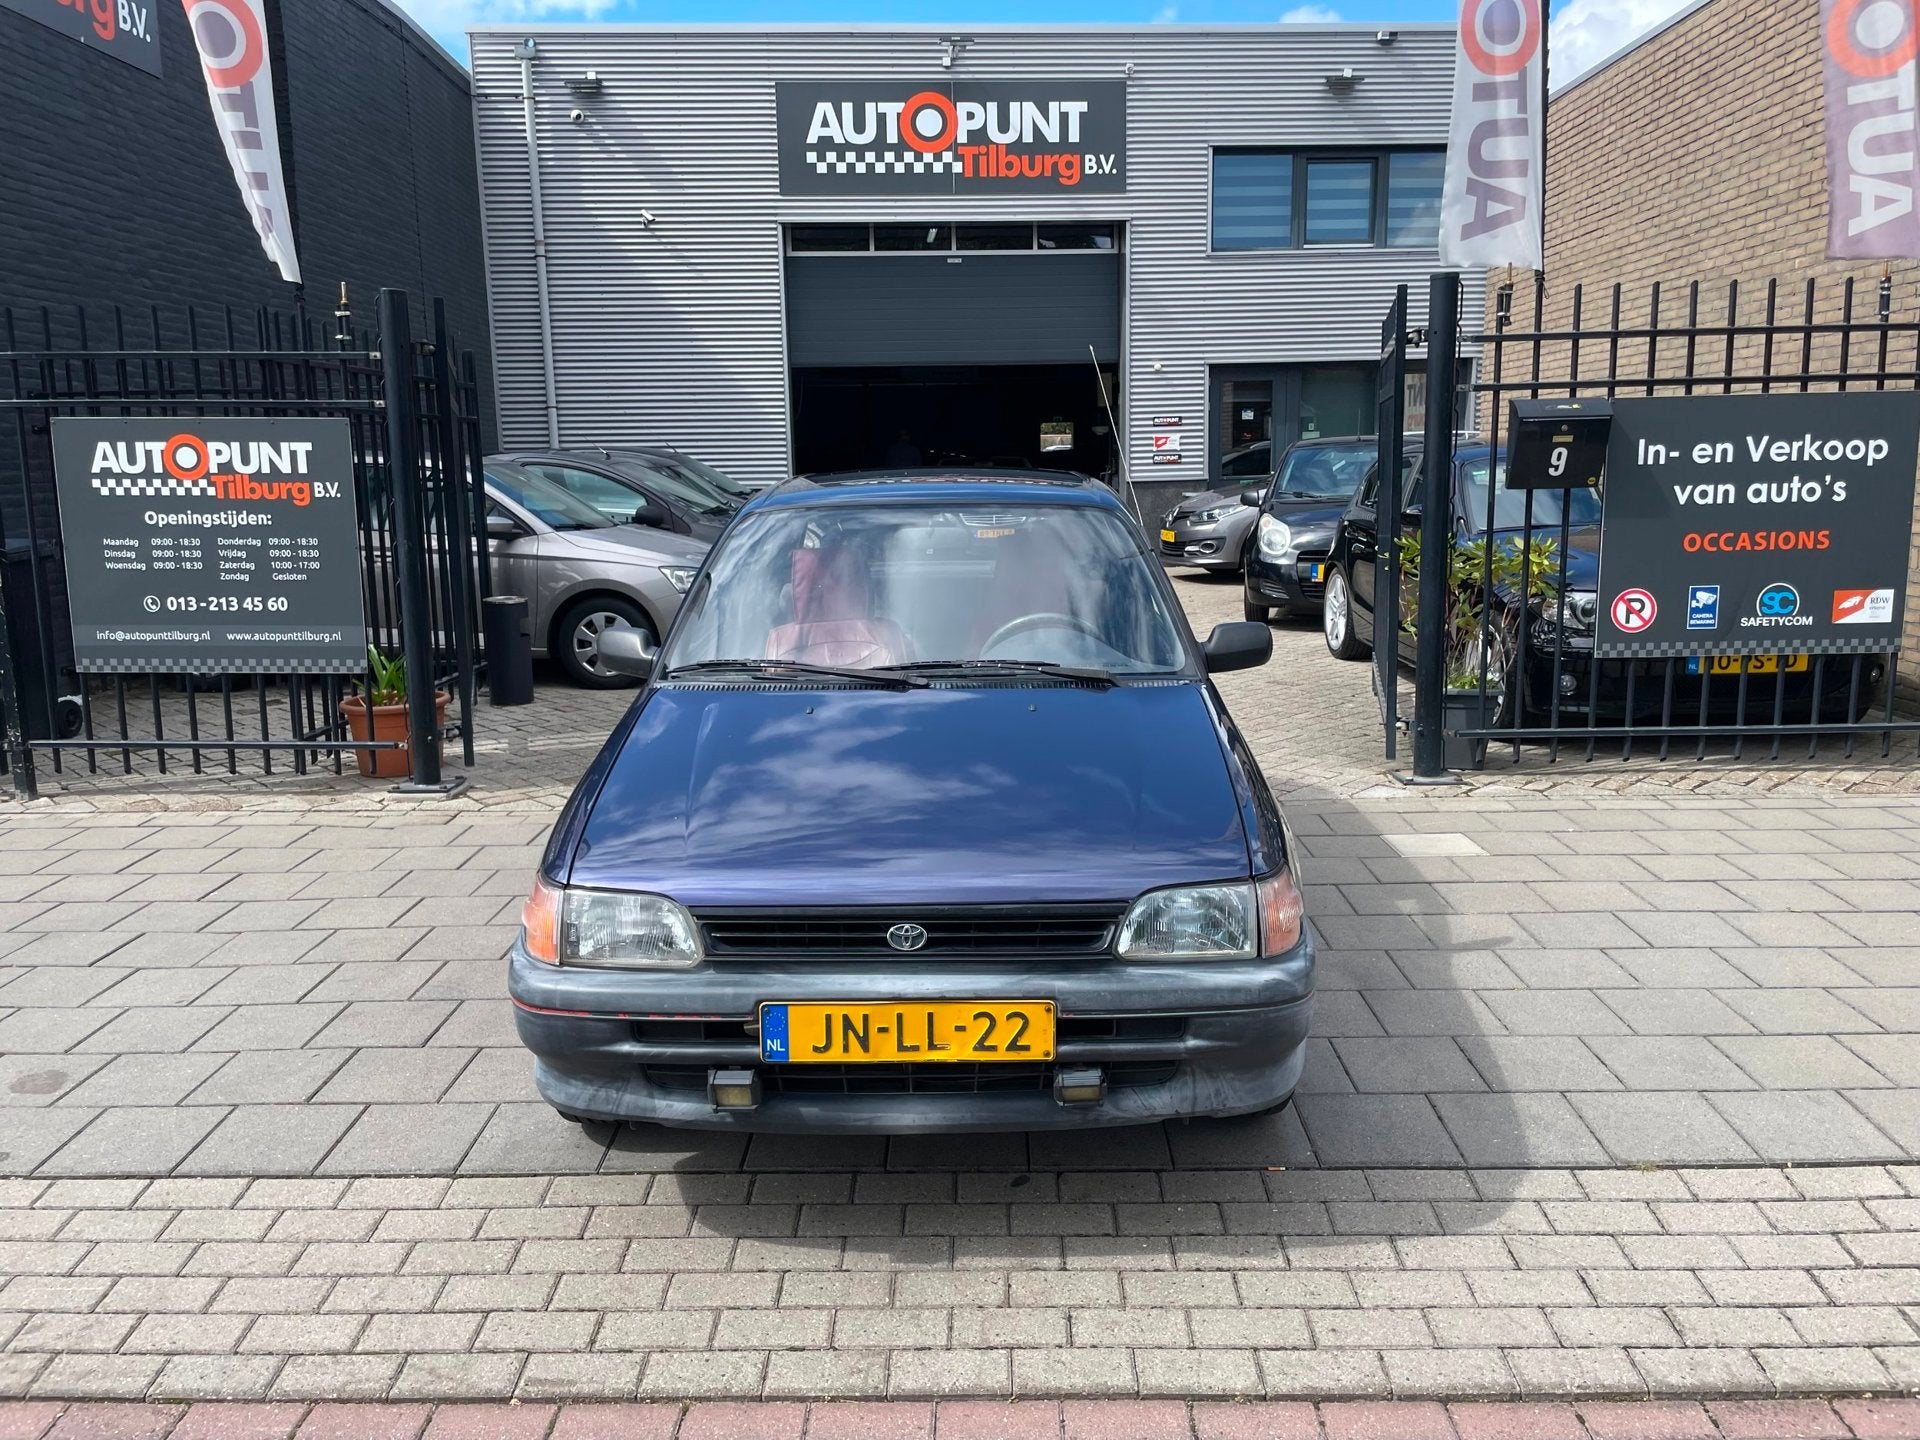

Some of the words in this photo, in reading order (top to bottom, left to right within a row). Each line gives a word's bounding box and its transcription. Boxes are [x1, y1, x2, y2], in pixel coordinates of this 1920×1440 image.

[117, 0, 151, 43] B.V.
[805, 91, 1089, 154] AUTOPUNT
[957, 144, 1081, 186] Tilburg
[1084, 153, 1118, 175] B.V.
[91, 433, 313, 481] AUTOPUNT
[1637, 439, 1680, 465] In-
[1692, 442, 1734, 464] en
[1746, 434, 1889, 466] Verkoop
[1548, 447, 1568, 477] 9
[210, 474, 311, 507] Tilburg
[313, 481, 342, 499] B.V.
[1673, 483, 1736, 505] van
[144, 509, 273, 528] Openingstijden:
[103, 538, 140, 548] Maandag
[151, 537, 173, 547] 09:00
[179, 537, 201, 547] 18:30
[217, 537, 262, 547] Donderdag
[268, 537, 291, 546] 09:00
[297, 537, 319, 546] 18:30
[1683, 530, 1831, 552] OCCASIONS
[104, 549, 136, 559] Dinsdag
[152, 549, 175, 558] 09:00
[180, 549, 202, 558] 18:30
[218, 549, 247, 559] Vrijdag
[269, 549, 292, 558] 09:00
[298, 549, 320, 558] 18:30
[105, 561, 147, 571] Woensdag
[153, 561, 176, 570] 09:00
[181, 561, 203, 570] 18:30
[219, 561, 255, 571] Zaterdag
[271, 561, 293, 569] 10:00
[299, 561, 320, 569] 17:00
[220, 572, 250, 582] Zondag
[272, 572, 307, 581] Gesloten
[242, 596, 264, 612] 45
[267, 596, 289, 612] 60
[1761, 591, 1795, 614] SC
[1870, 596, 1890, 604] RDW
[1740, 616, 1813, 627] SAFETYCOM
[96, 630, 211, 642] info@autopunttilburg.nl
[226, 631, 342, 643] www.autopunttilburg.nl
[812, 1011, 1031, 1054] JN-LL-22
[767, 1039, 785, 1052] NL
